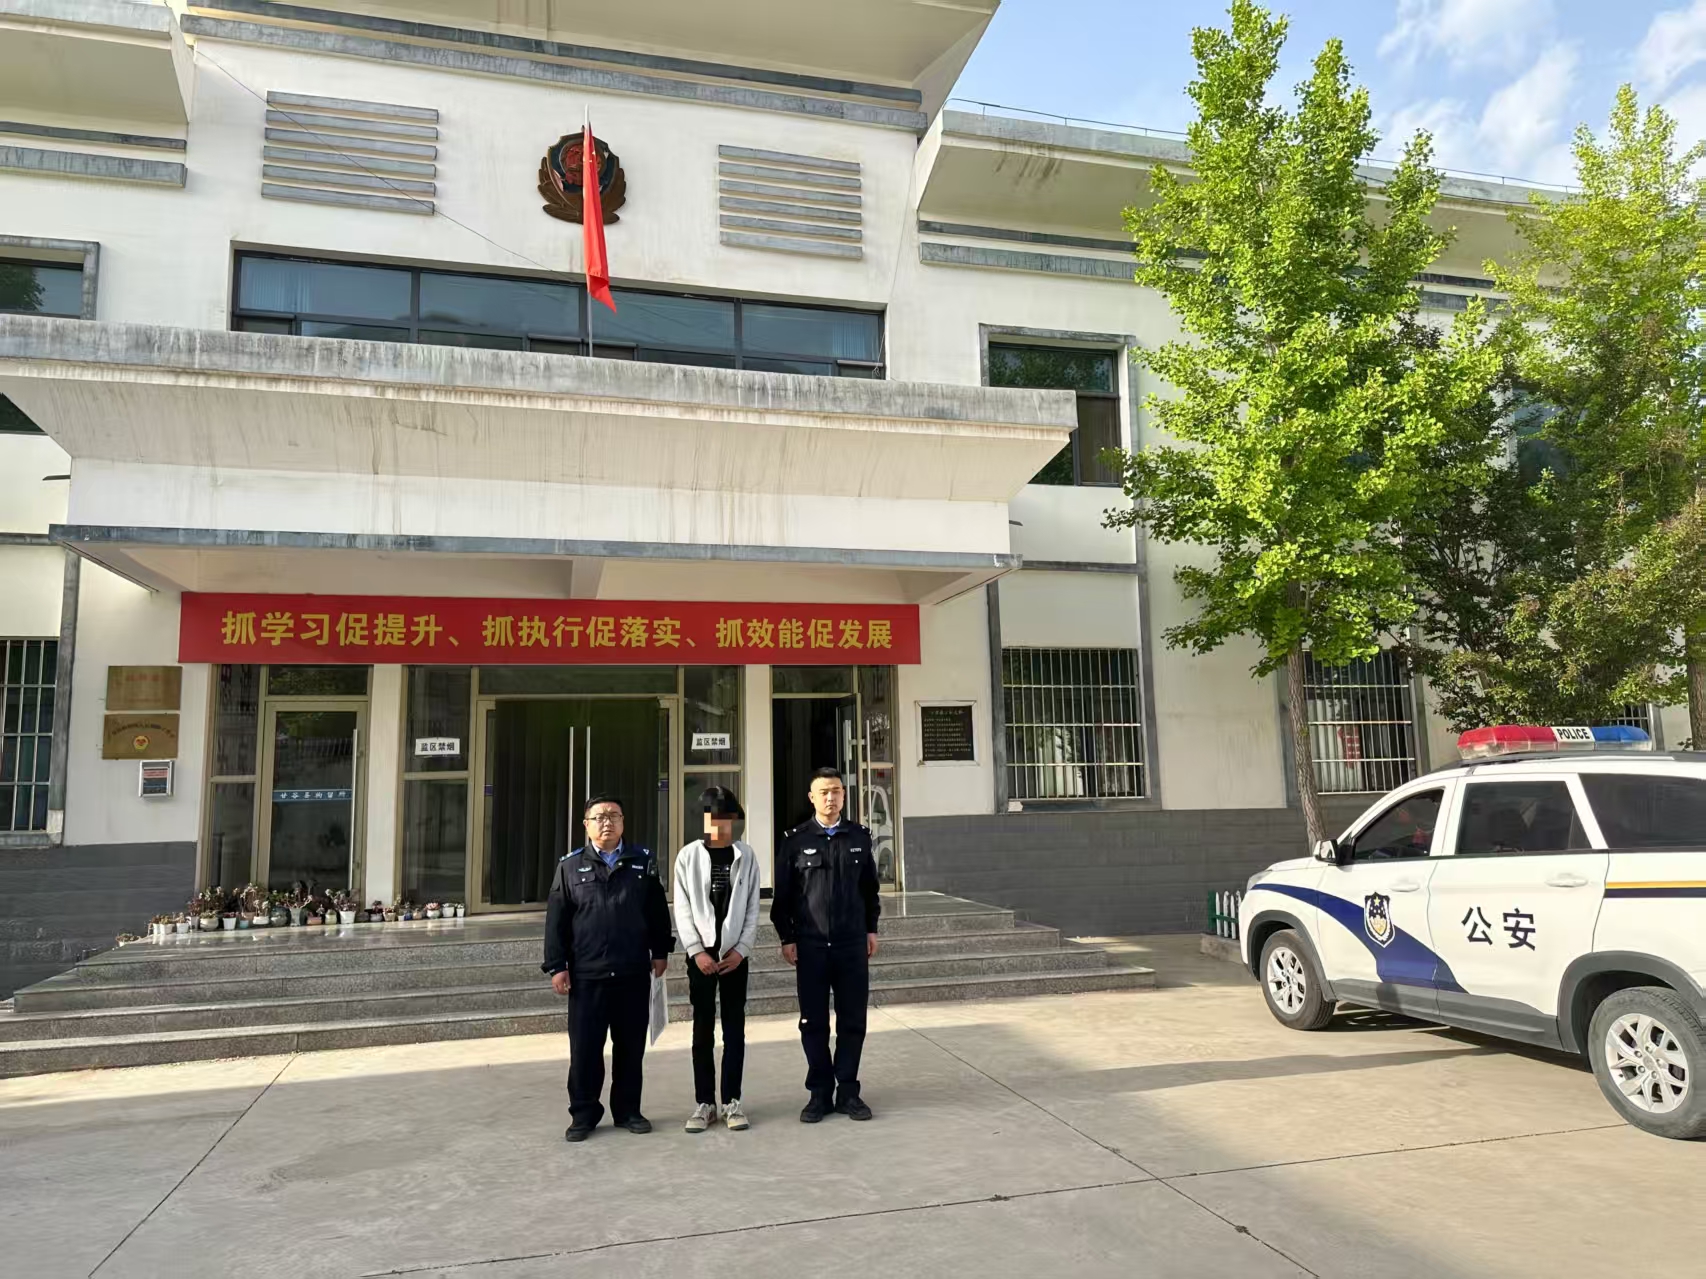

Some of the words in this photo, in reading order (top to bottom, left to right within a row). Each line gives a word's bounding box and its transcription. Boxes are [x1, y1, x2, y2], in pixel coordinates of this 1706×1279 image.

[221, 610, 893, 649] 抓学习促提升、抓执行促落实、抓效能促发展
[1556, 728, 1590, 739] POLICE
[1461, 906, 1536, 951] 公安
